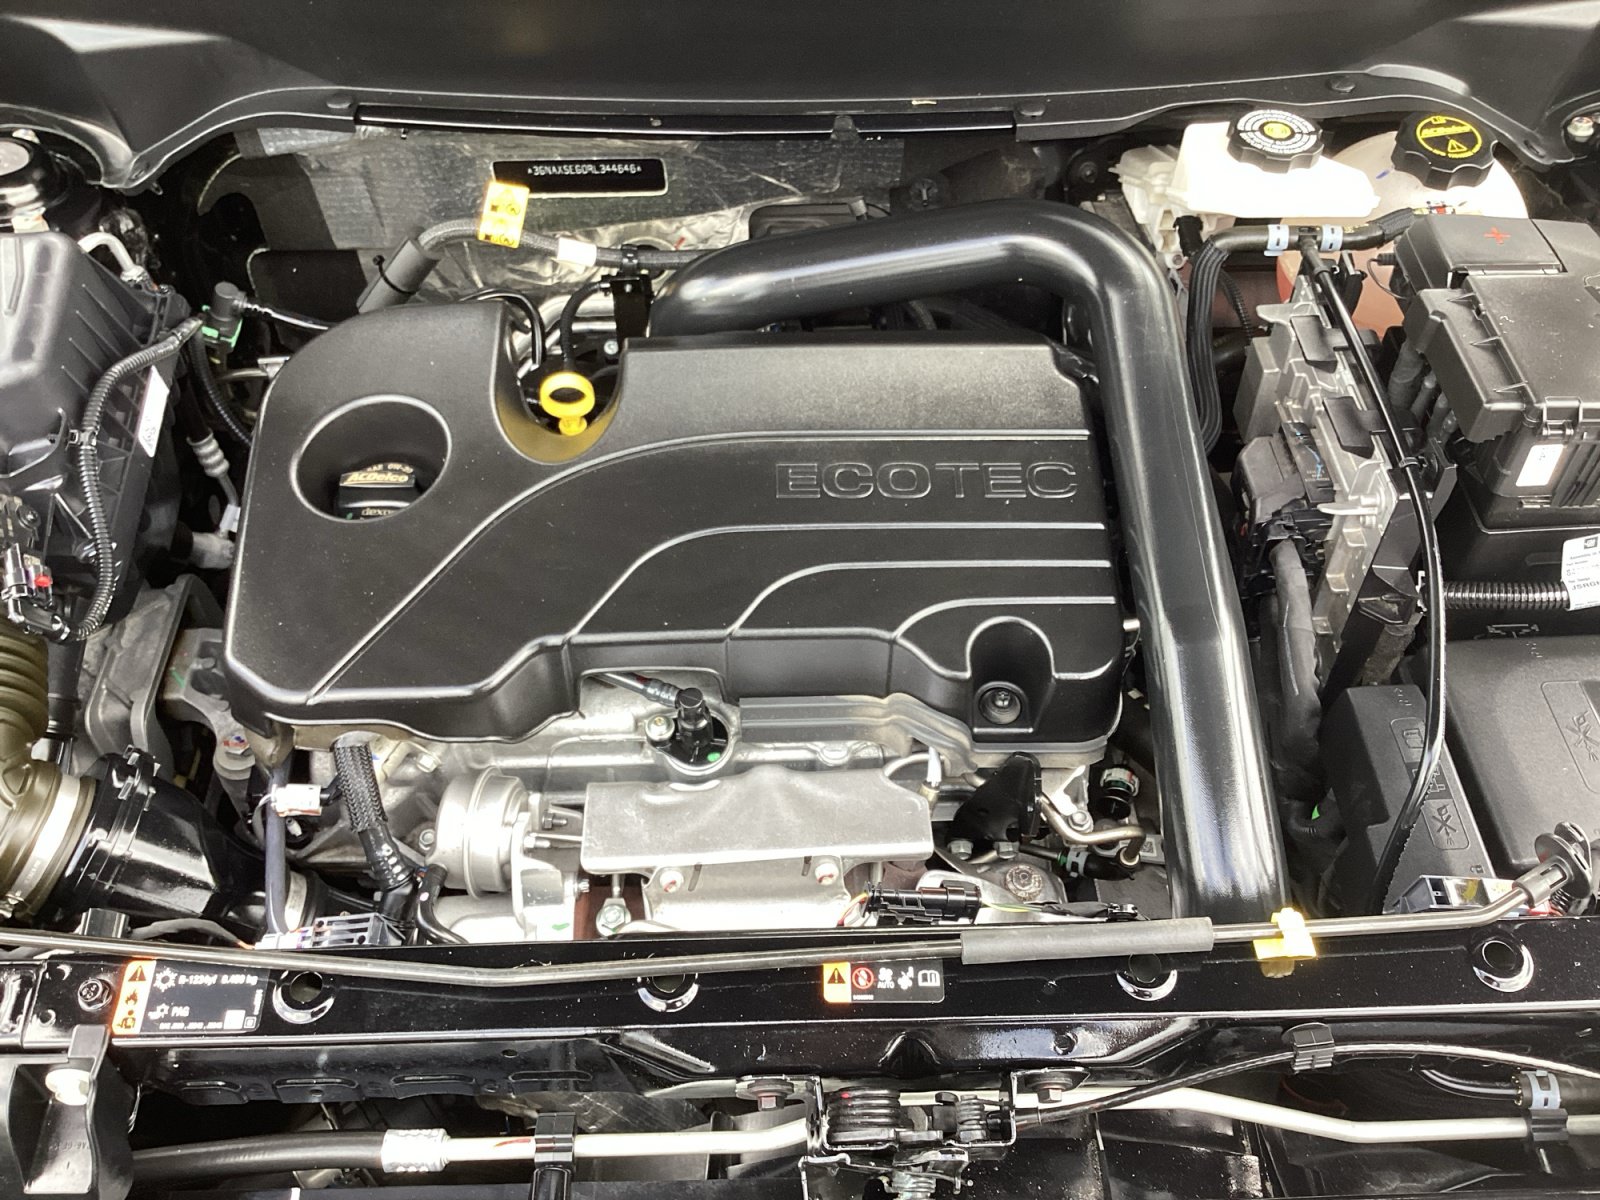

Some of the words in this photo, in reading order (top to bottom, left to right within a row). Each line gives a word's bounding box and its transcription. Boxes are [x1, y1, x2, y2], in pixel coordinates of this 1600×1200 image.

[344, 471, 409, 483] ACDelco
[776, 462, 1077, 498] ECOTEC
[877, 981, 895, 989] AUTO
